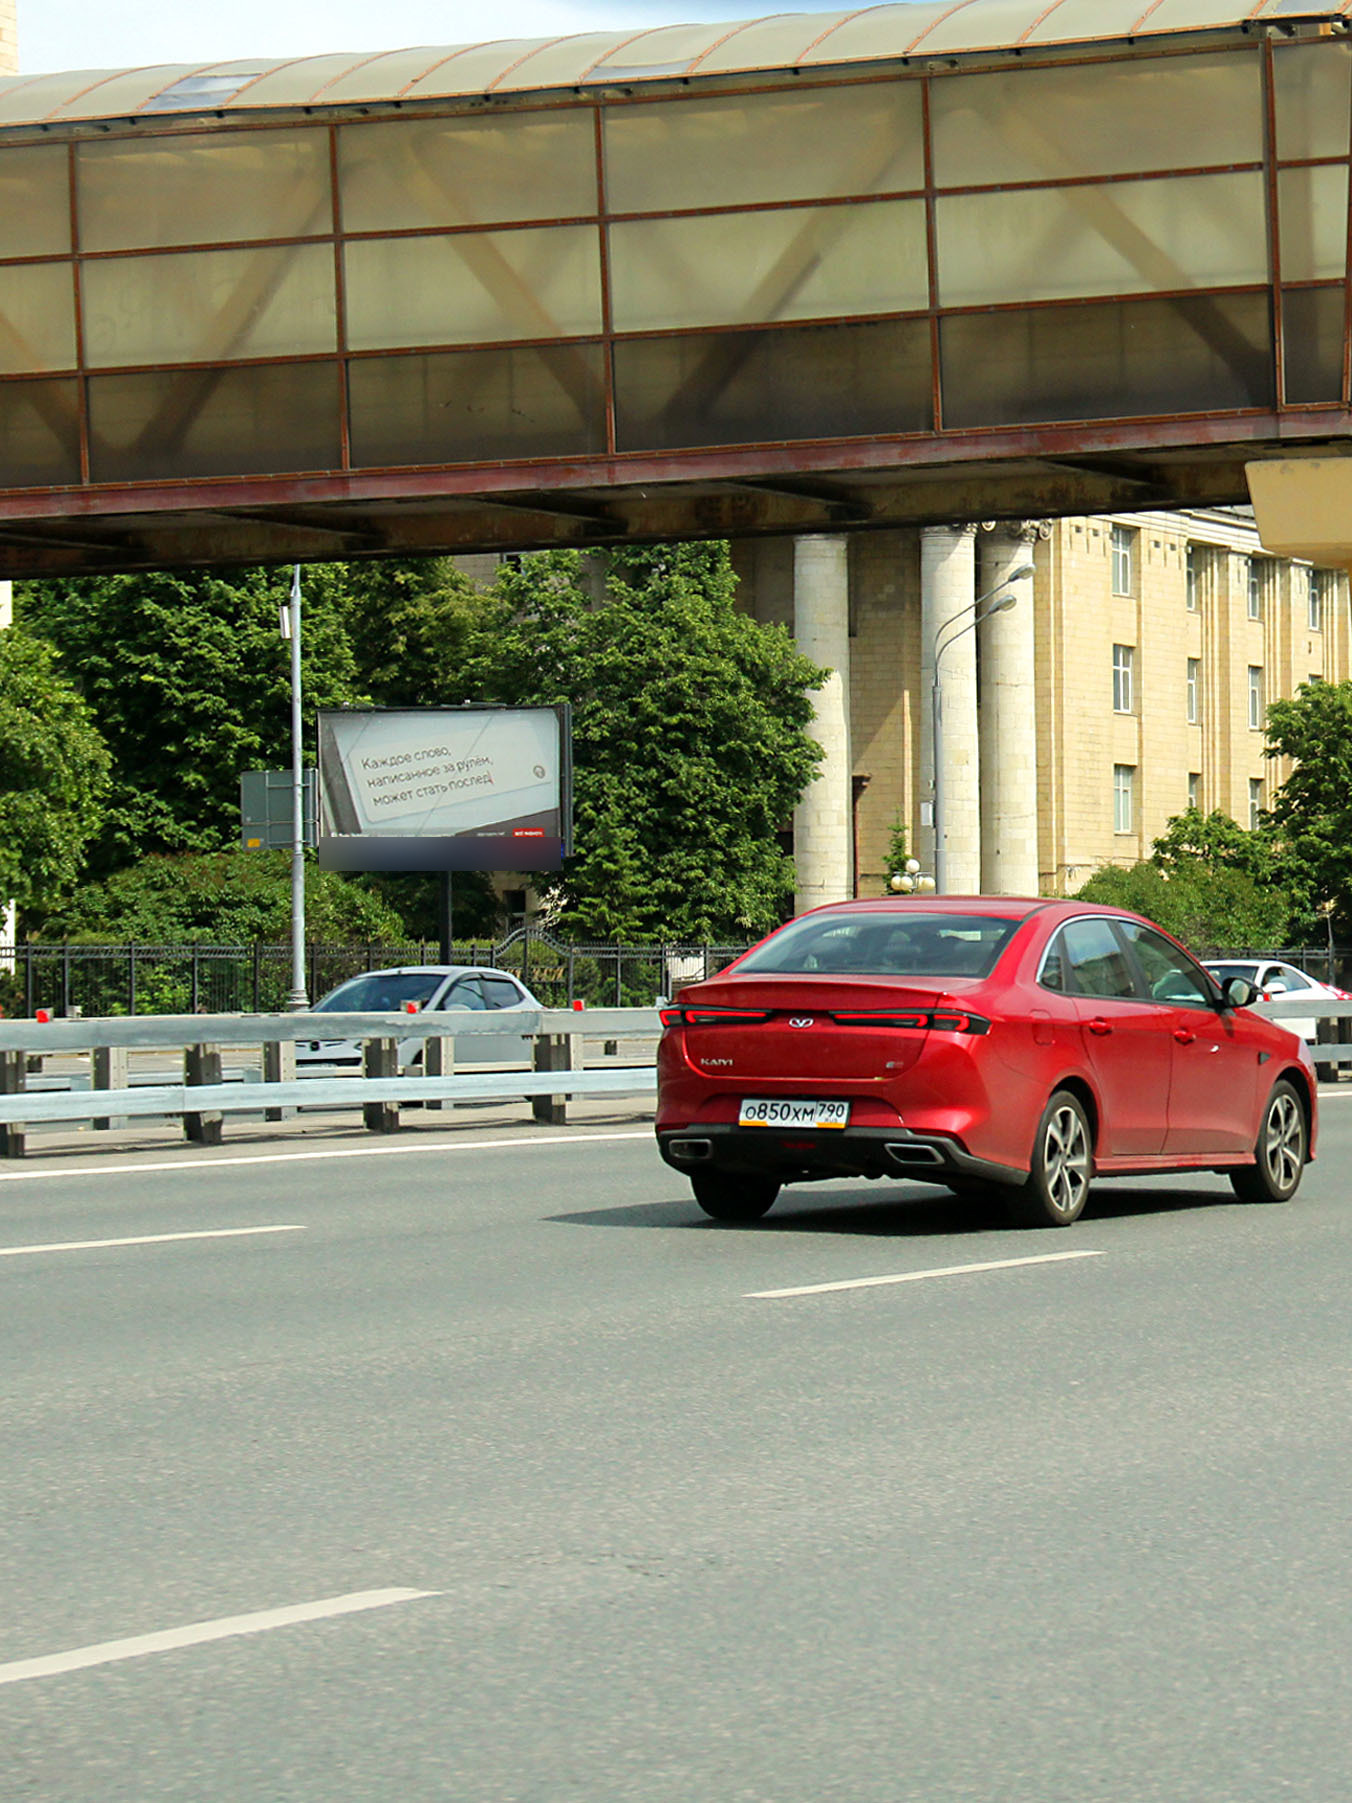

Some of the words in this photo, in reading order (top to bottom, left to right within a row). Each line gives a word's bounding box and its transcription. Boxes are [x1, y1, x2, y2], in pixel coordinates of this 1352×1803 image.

[361, 752, 412, 770] Каждое
[414, 746, 452, 760] слово,
[367, 766, 441, 788] написанное
[443, 762, 455, 774] за
[373, 789, 414, 806] может
[415, 782, 448, 798] стать
[449, 774, 492, 790] послед
[700, 1058, 734, 1067] KAIYI
[818, 1103, 845, 1118] 790
